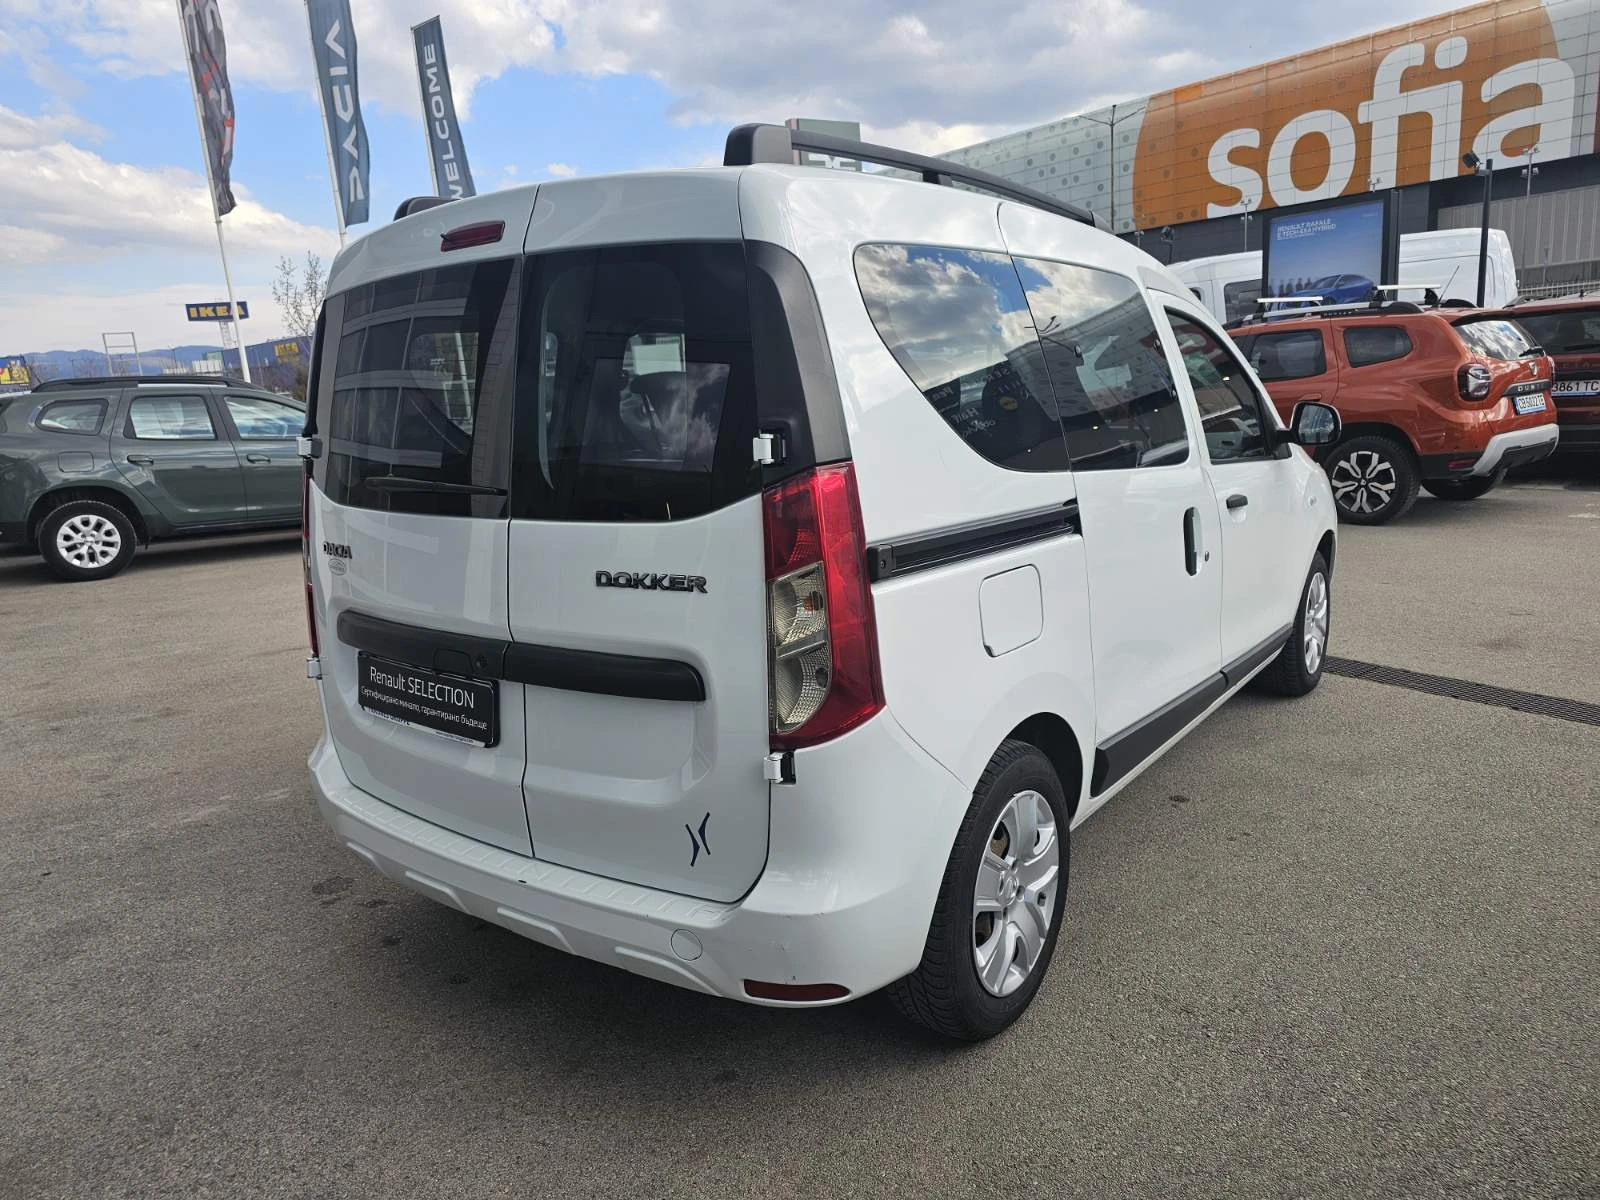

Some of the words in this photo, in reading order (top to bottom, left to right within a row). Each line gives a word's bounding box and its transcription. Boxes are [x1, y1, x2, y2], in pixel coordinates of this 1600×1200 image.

[325, 19, 365, 203] DACIA
[424, 43, 464, 201] WELCOME
[1207, 36, 1576, 219] sofia
[189, 305, 246, 318] IKEA
[323, 541, 352, 560] DACIA
[596, 570, 708, 594] DOKKER
[370, 666, 406, 692] Renault
[408, 677, 475, 709] SELECTION
[421, 705, 460, 722] гарантирано
[461, 714, 488, 730] бъдеще
